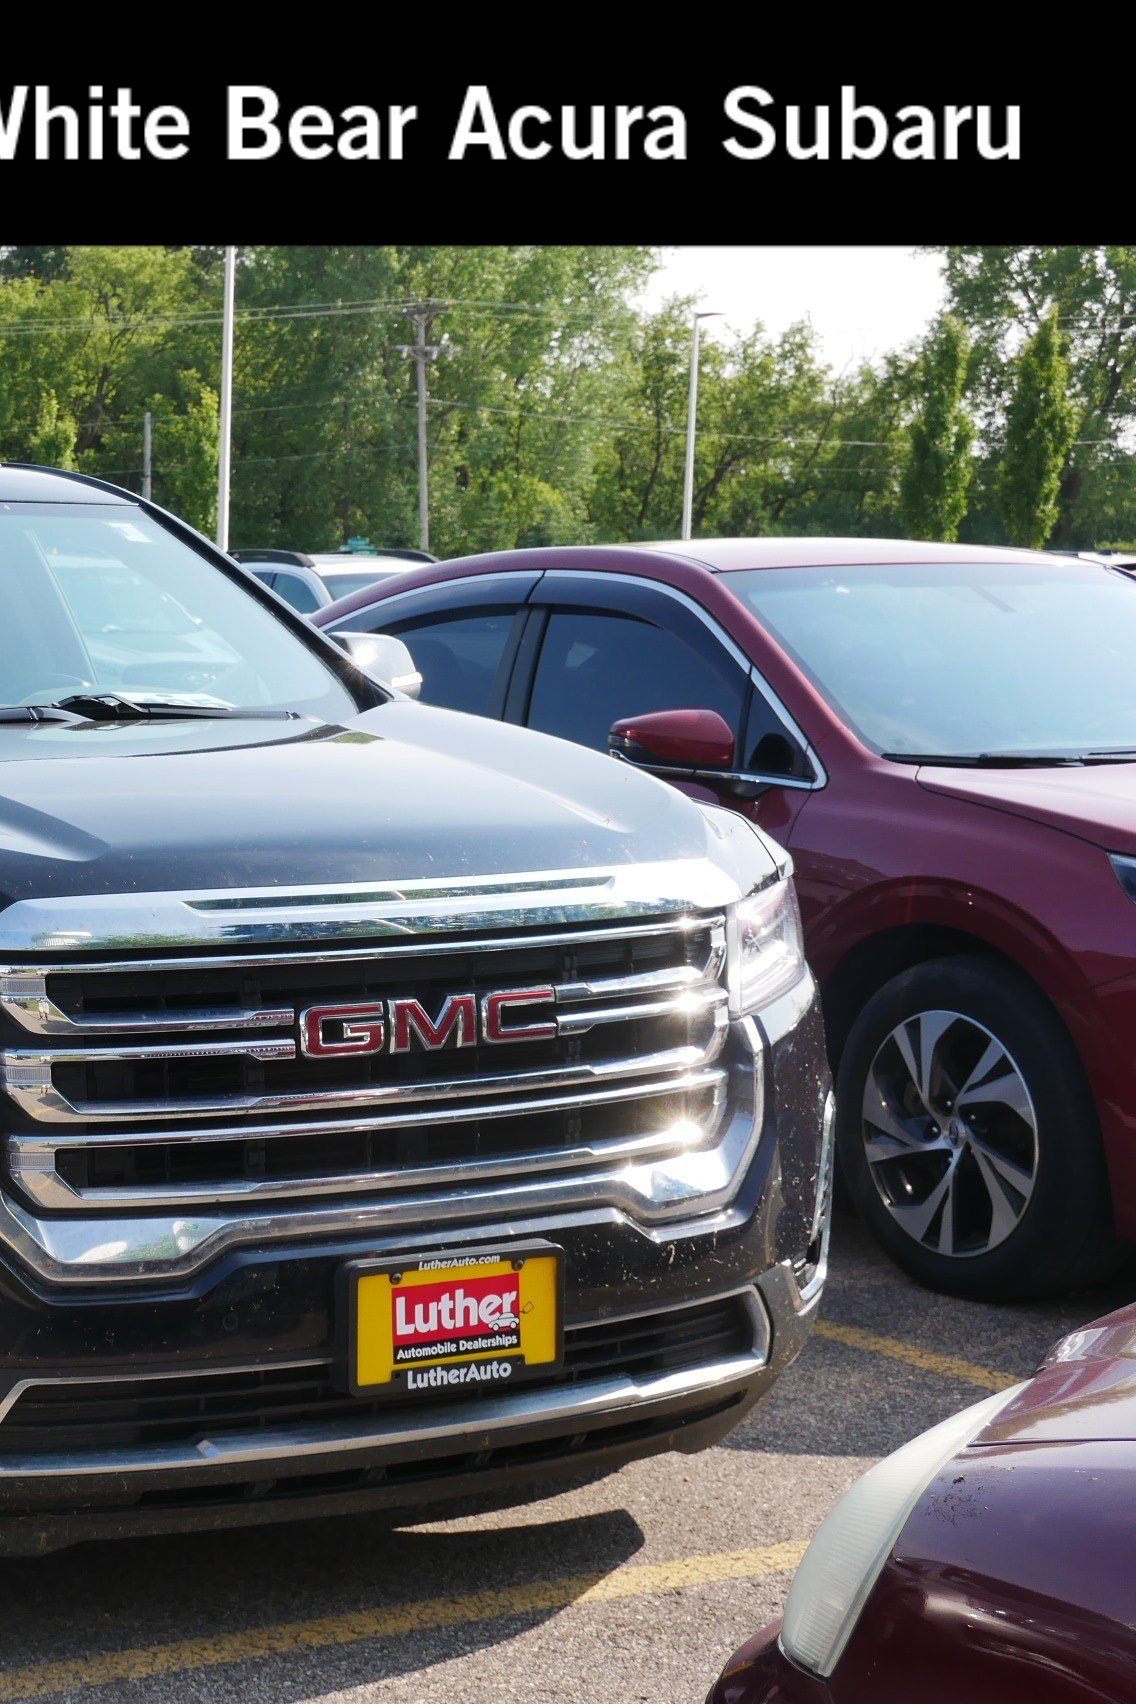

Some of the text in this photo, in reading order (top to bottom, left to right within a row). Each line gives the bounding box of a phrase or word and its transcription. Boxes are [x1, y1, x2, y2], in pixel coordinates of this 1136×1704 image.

[299, 984, 557, 1058] GMC
[418, 1255, 500, 1271] LutherAuto.com
[395, 1288, 518, 1336] Luther
[396, 1334, 518, 1360] Automobile Dealerships
[407, 1360, 512, 1389] LutherAuto
